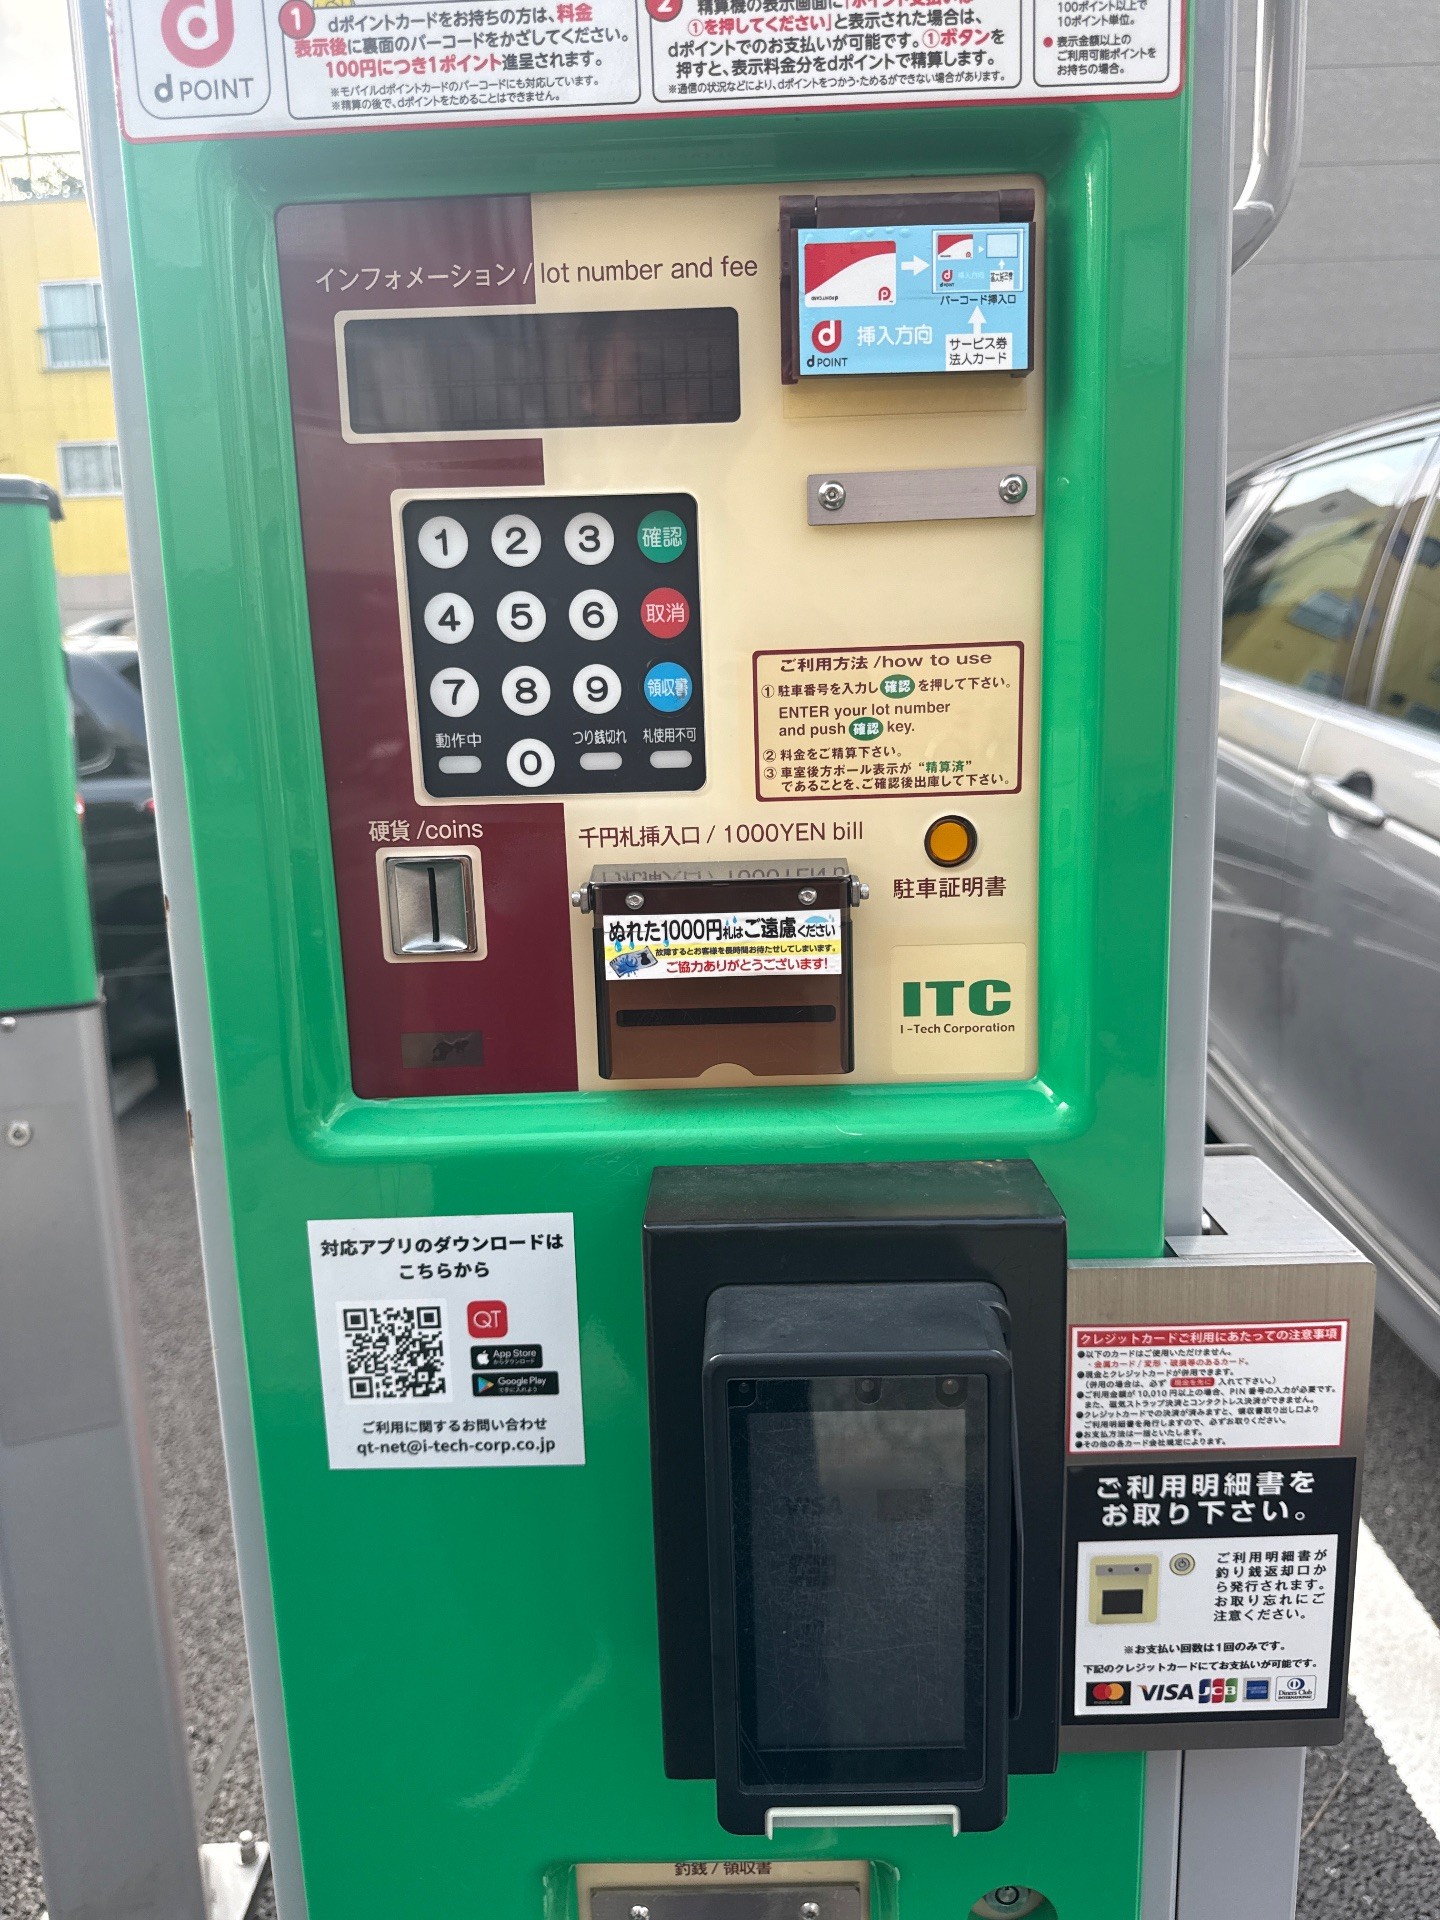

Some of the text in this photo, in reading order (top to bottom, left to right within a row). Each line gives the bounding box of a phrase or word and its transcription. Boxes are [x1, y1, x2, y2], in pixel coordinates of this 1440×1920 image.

[1058, 0, 1147, 12] 100ポイント以上で
[328, 3, 593, 33] dポイントカードをお持ちの方は、料金
[1058, 14, 1135, 27] 10ポイント単位。
[295, 27, 628, 57] 表示後に裏面のバーコードをかざしてください。
[1057, 34, 1131, 47] 表示金額以上の
[1057, 47, 1156, 61] ご利用可能ポイントを
[326, 51, 603, 78] 100円につき1ポイント進呈されます。
[676, 49, 995, 79] 押すと、表示料金分をdポイントで精算します。
[1057, 63, 1125, 76] お持ちの場合。
[180, 78, 254, 101] POINT
[331, 75, 599, 96] ※モバイルdポイントカードのバーコードにも対応しています。
[315, 262, 516, 293] インフォメーション
[540, 262, 570, 283] lot
[577, 260, 664, 282] number
[671, 257, 713, 279] and
[720, 256, 758, 277] fee
[939, 294, 1017, 306] バーコード挿入口
[857, 324, 933, 347] 挿入方向
[949, 337, 1008, 350] サービス券
[817, 357, 848, 367] POINT
[949, 352, 1007, 366] 法人カード
[435, 529, 448, 556] 1
[505, 526, 528, 555] 2
[578, 525, 600, 552] 3
[641, 527, 683, 548] 確認
[438, 605, 461, 631] 4
[510, 603, 533, 630] 5
[582, 601, 605, 628] 6
[645, 603, 685, 624] 取消
[780, 656, 868, 673] ご利用方法
[930, 653, 950, 666] to
[956, 653, 992, 665] use
[442, 679, 465, 705] 7
[515, 677, 538, 704] 8
[586, 676, 608, 702] 9
[647, 677, 689, 699] 領収書
[777, 681, 878, 697] 駐車番号を入力し
[883, 679, 911, 694] 確認
[918, 676, 1011, 692] を押して下さい。
[779, 701, 950, 721] ENTER your lot number
[573, 729, 627, 745] つり銭切れ
[643, 728, 697, 743] 札使用不可
[778, 720, 915, 738] and push 確認 key.
[434, 732, 482, 749] 動作中
[519, 750, 542, 775] 0
[780, 745, 902, 761] 料金をご精算下さい。
[781, 761, 912, 778] 車室後方ポール表示が
[781, 773, 1010, 793] であることを、ご確認後出庫して下さい。
[369, 820, 411, 842] 硬貨
[578, 825, 701, 848] 千円札挿入口
[724, 822, 827, 844] 1000YEN
[833, 821, 864, 842] bill
[893, 876, 1007, 899] 駐車証明書
[609, 916, 836, 943] ぬれた1000円札はご遠慮ください
[655, 943, 837, 957] 故障するとお客様を長時間お待たせしてしまいます。
[902, 979, 1012, 1018] ITC
[943, 1022, 1016, 1035] Corporation
[320, 1233, 564, 1257] 対応アプリのダウンロードは
[399, 1261, 490, 1280] こちらから
[473, 1310, 502, 1328] QT
[1080, 1328, 1338, 1345] クレジットカードご利用にあたっての注意事項
[493, 1348, 537, 1359] App Store
[497, 1375, 547, 1387] Google Play
[1229, 1387, 1246, 1396] PIN
[362, 1417, 548, 1434] ご利用に関するお問い合わせ
[357, 1437, 556, 1456] qt-net@i-tech-corp.co.jp
[1096, 1470, 1315, 1499] ご利用明細書を
[1101, 1500, 1306, 1527] お取り下さい。
[1216, 1548, 1328, 1564] ご利用明細書が
[1215, 1565, 1327, 1578] 釣り銭返却口か
[1216, 1578, 1324, 1592] ら発行されます。
[1214, 1593, 1325, 1607] お取り忘れにご
[1213, 1608, 1306, 1622] 注意ください。
[1083, 1658, 1317, 1674] 下記のクレジットカードにてお支払いが可能です。
[1138, 1683, 1194, 1701] VISA
[675, 1862, 708, 1876] 釣銭
[723, 1862, 772, 1875] 領収書
